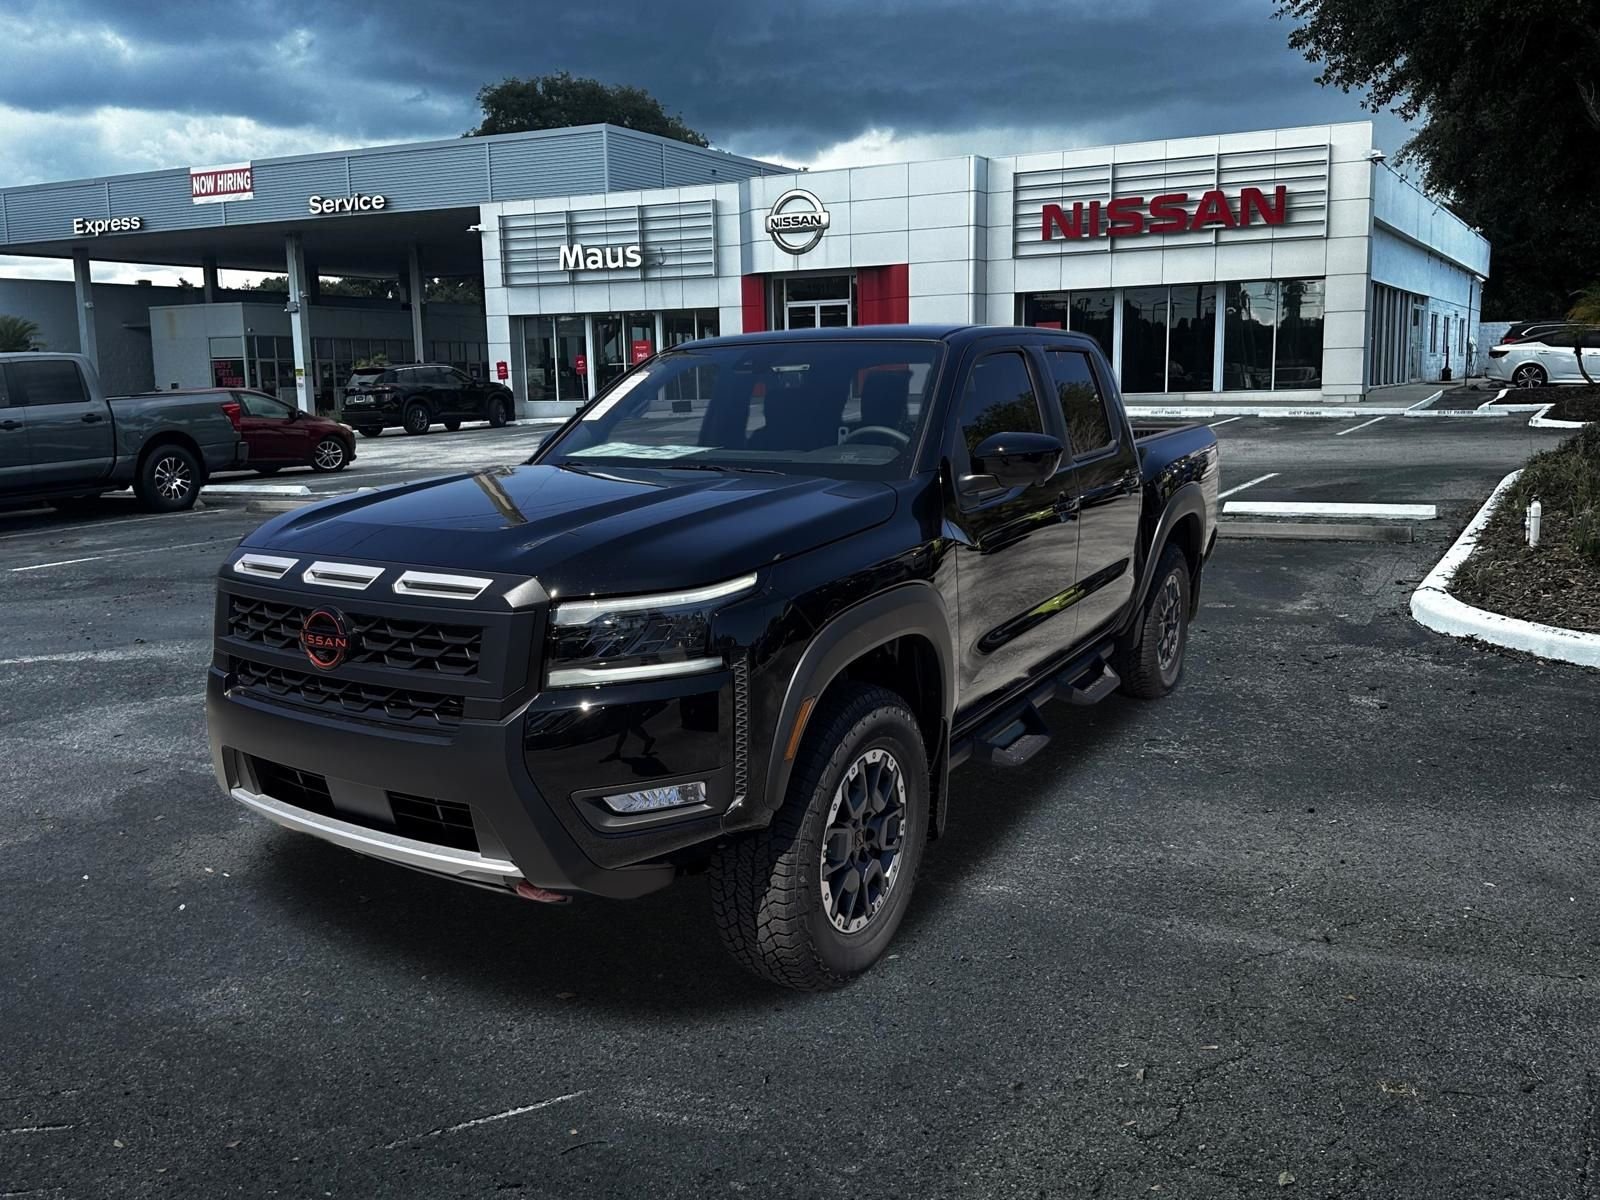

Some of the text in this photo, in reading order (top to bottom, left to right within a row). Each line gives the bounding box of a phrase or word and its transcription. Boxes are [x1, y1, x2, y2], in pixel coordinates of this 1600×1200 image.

[192, 171, 251, 195] NOW HIRING
[309, 193, 385, 214] Service
[1042, 185, 1287, 241] NISSAN
[73, 216, 141, 236] Express
[770, 215, 822, 228] NISSAN
[559, 243, 642, 271] Maus
